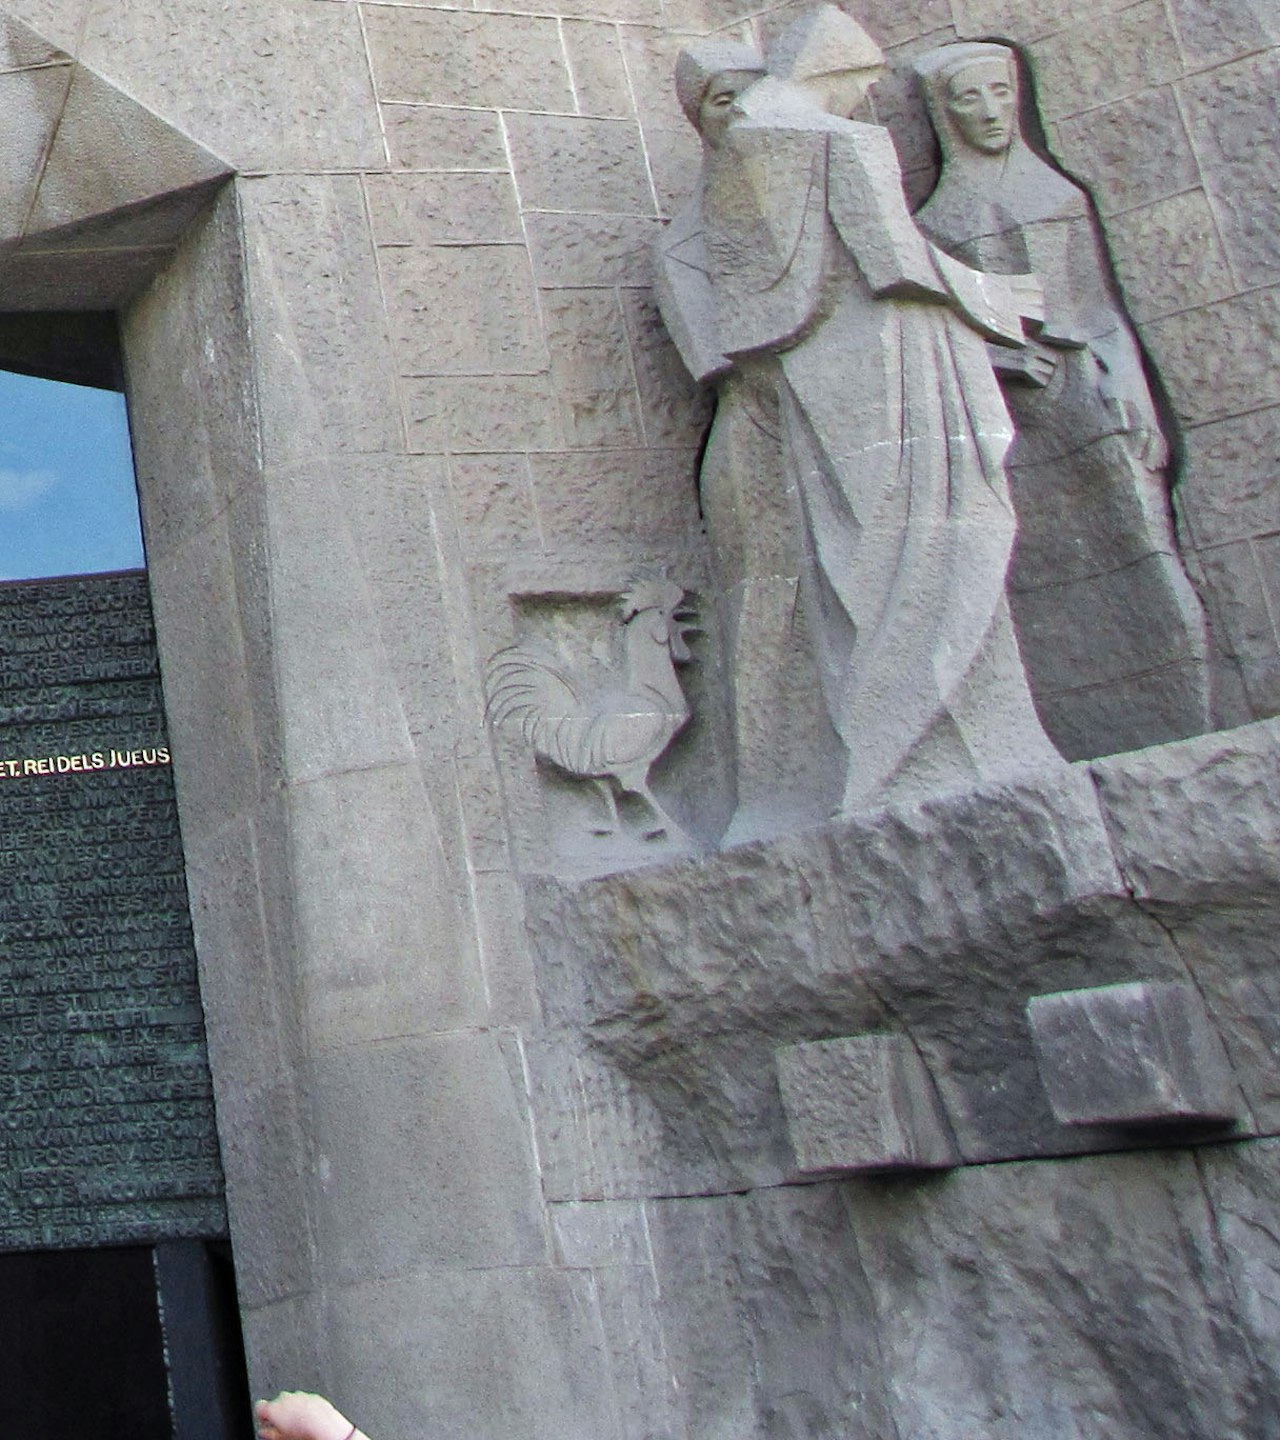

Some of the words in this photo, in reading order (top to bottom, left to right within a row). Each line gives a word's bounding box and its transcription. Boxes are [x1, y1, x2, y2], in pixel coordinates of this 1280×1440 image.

[23, 757, 55, 777] REI
[56, 752, 106, 774] DELS
[109, 746, 172, 769] JUEUS
